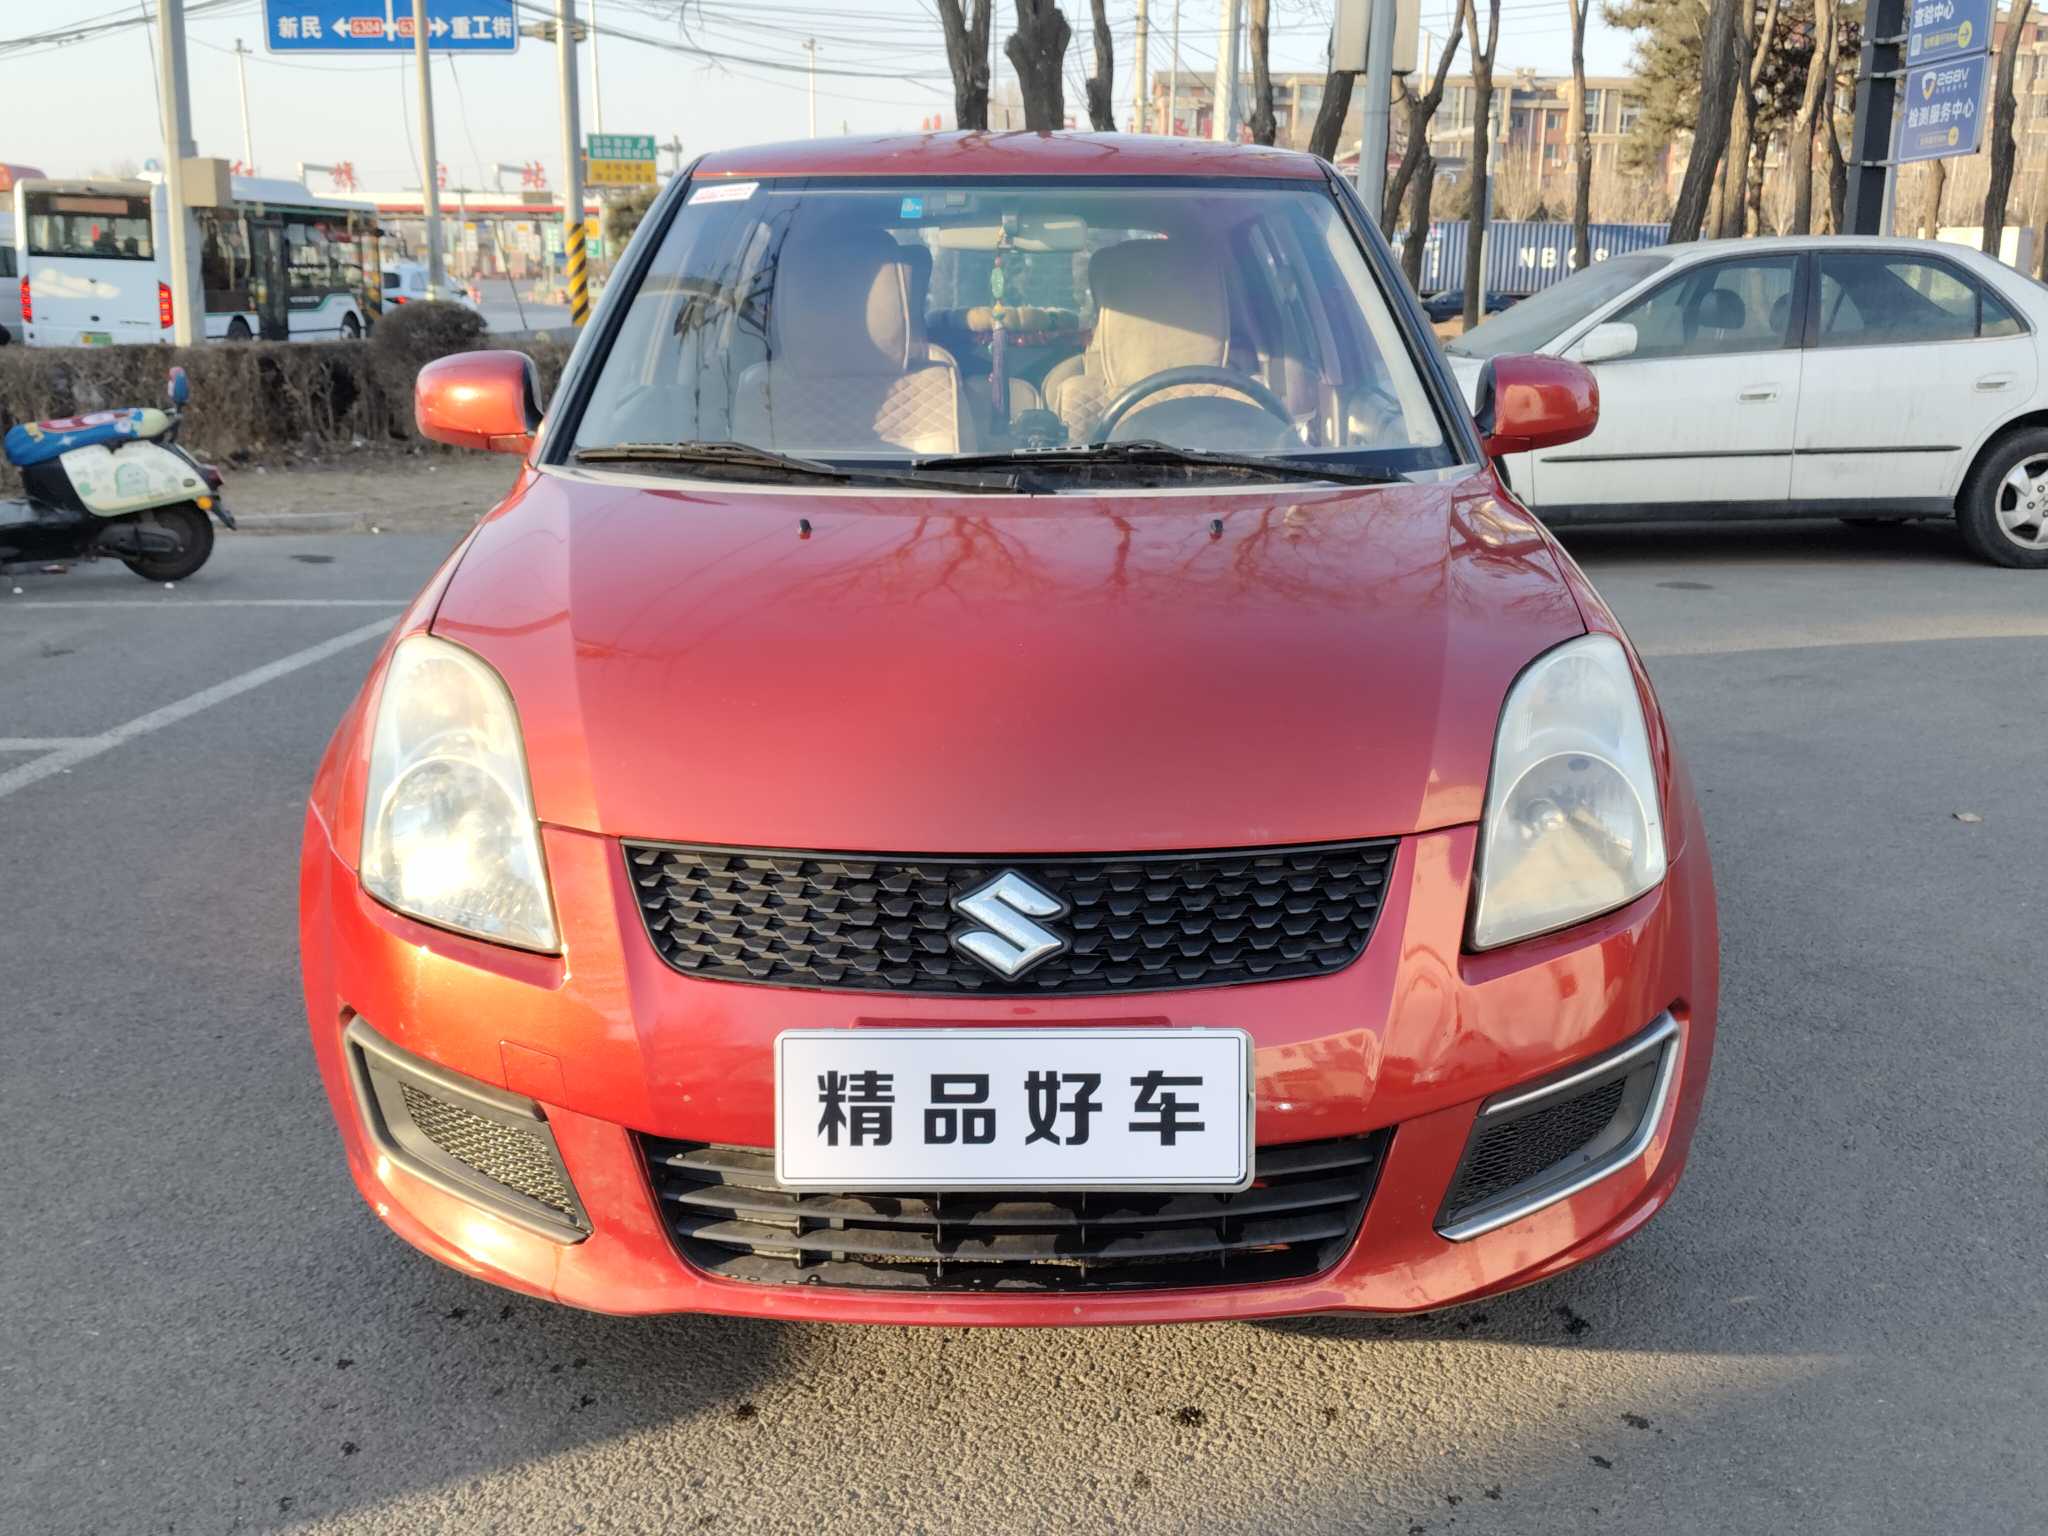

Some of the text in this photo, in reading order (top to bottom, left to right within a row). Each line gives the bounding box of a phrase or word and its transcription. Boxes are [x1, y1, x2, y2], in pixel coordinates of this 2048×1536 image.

[278, 15, 322, 38] 新民
[450, 15, 512, 39] 重工街
[1908, 97, 1974, 128] 检测服务中心
[817, 1070, 1205, 1146] 精品好车
